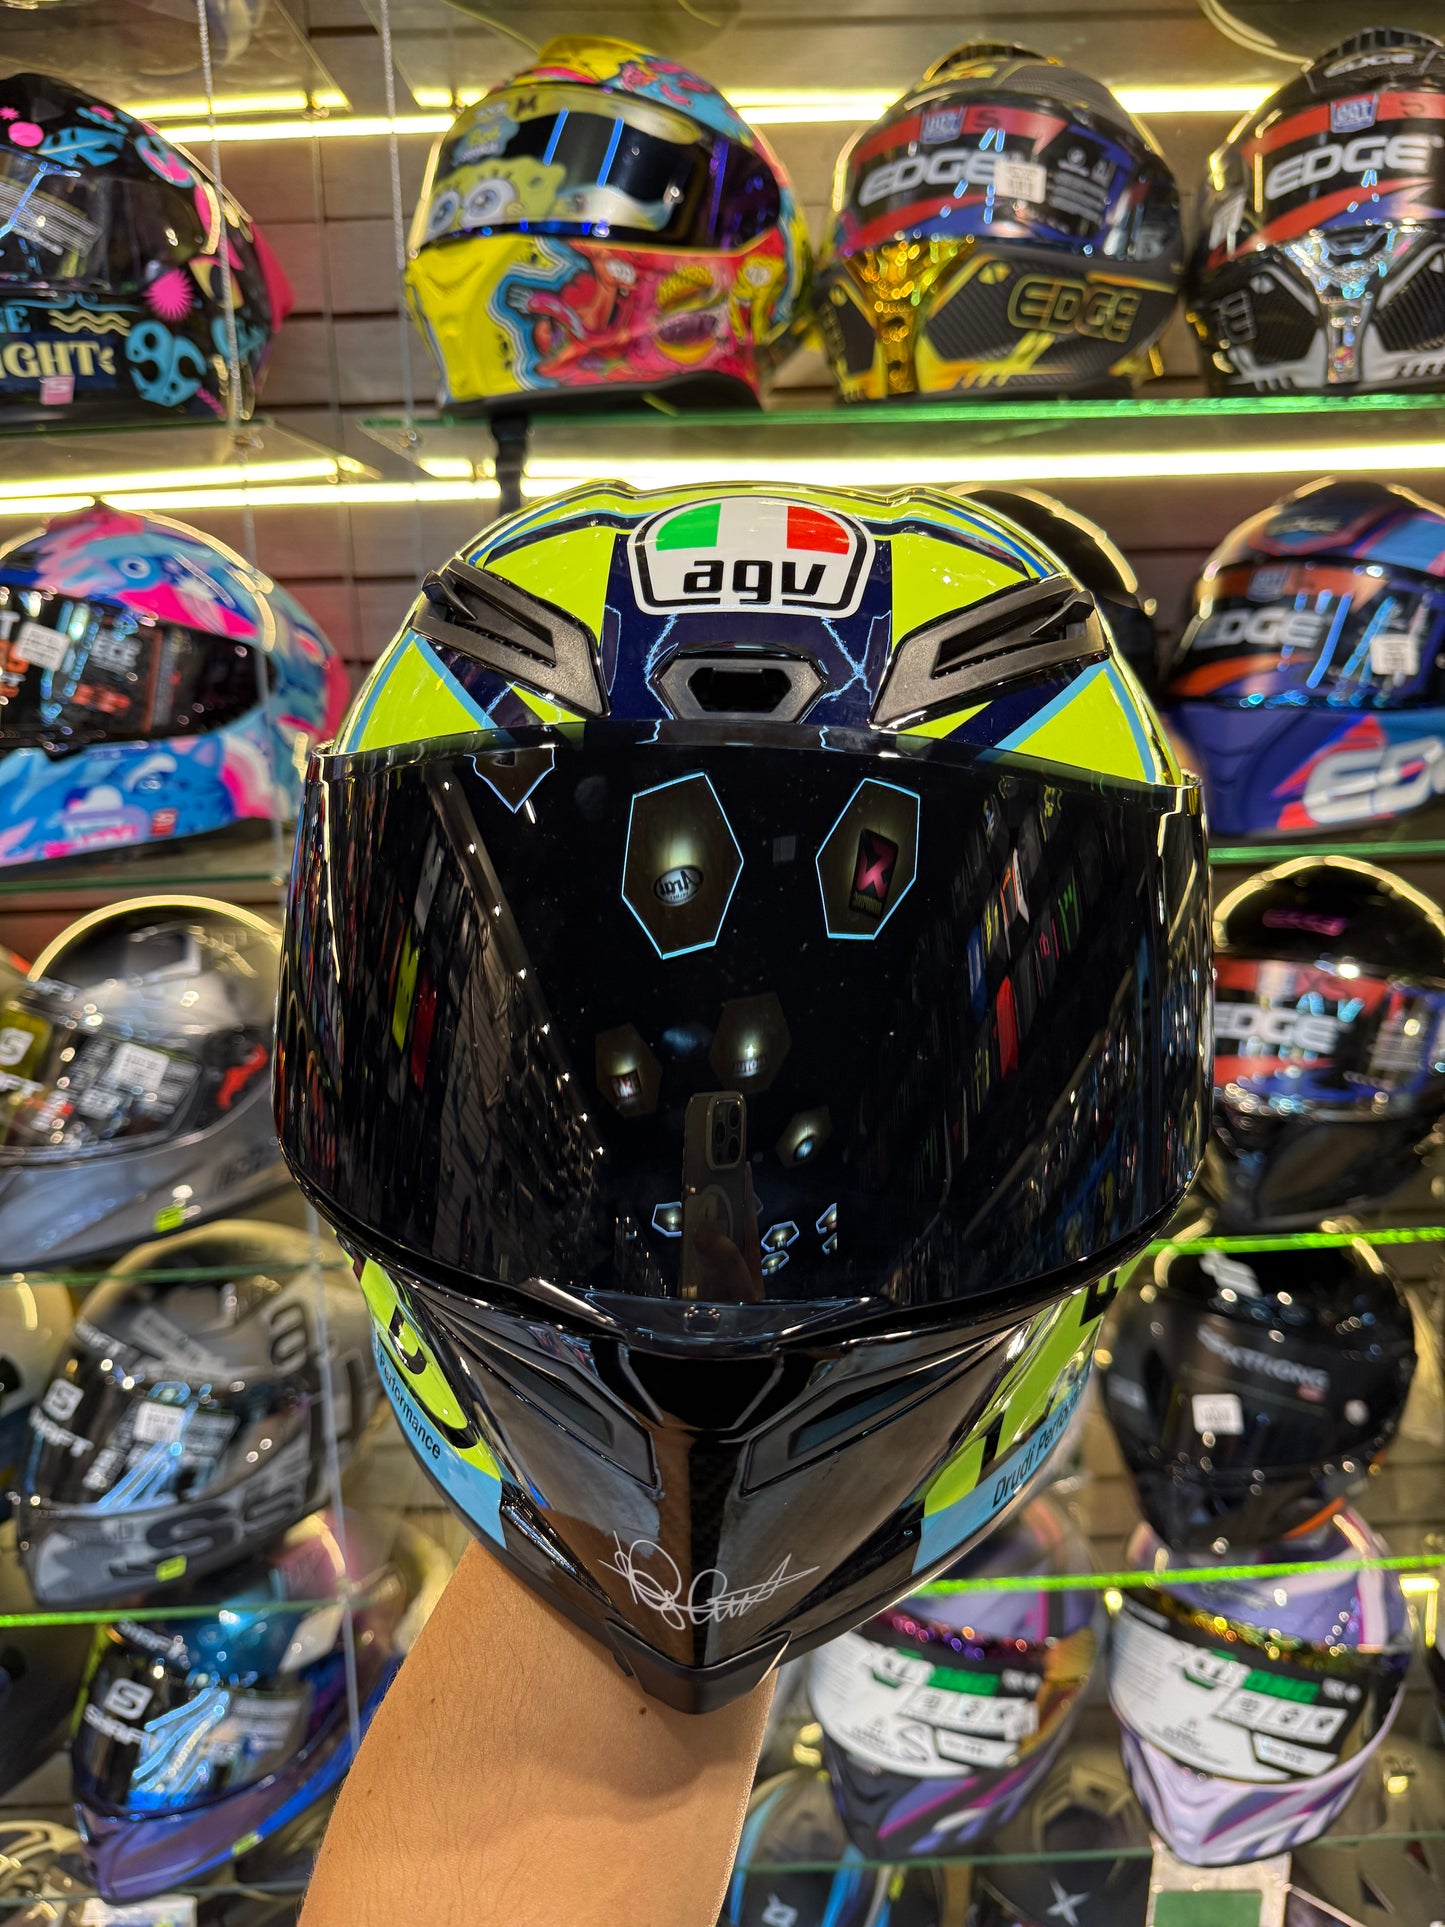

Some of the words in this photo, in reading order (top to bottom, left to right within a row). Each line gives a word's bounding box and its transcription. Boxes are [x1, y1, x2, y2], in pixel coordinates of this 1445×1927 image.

[858, 150, 1006, 207] EDGE
[1265, 134, 1431, 200] EDGE
[0, 306, 31, 333] E
[1008, 273, 1141, 342] EDGE
[0, 341, 100, 379] GHT
[683, 560, 827, 605] agv
[1303, 735, 1445, 823] ED
[379, 1351, 441, 1460] Performance
[992, 1444, 1035, 1508] Drudi
